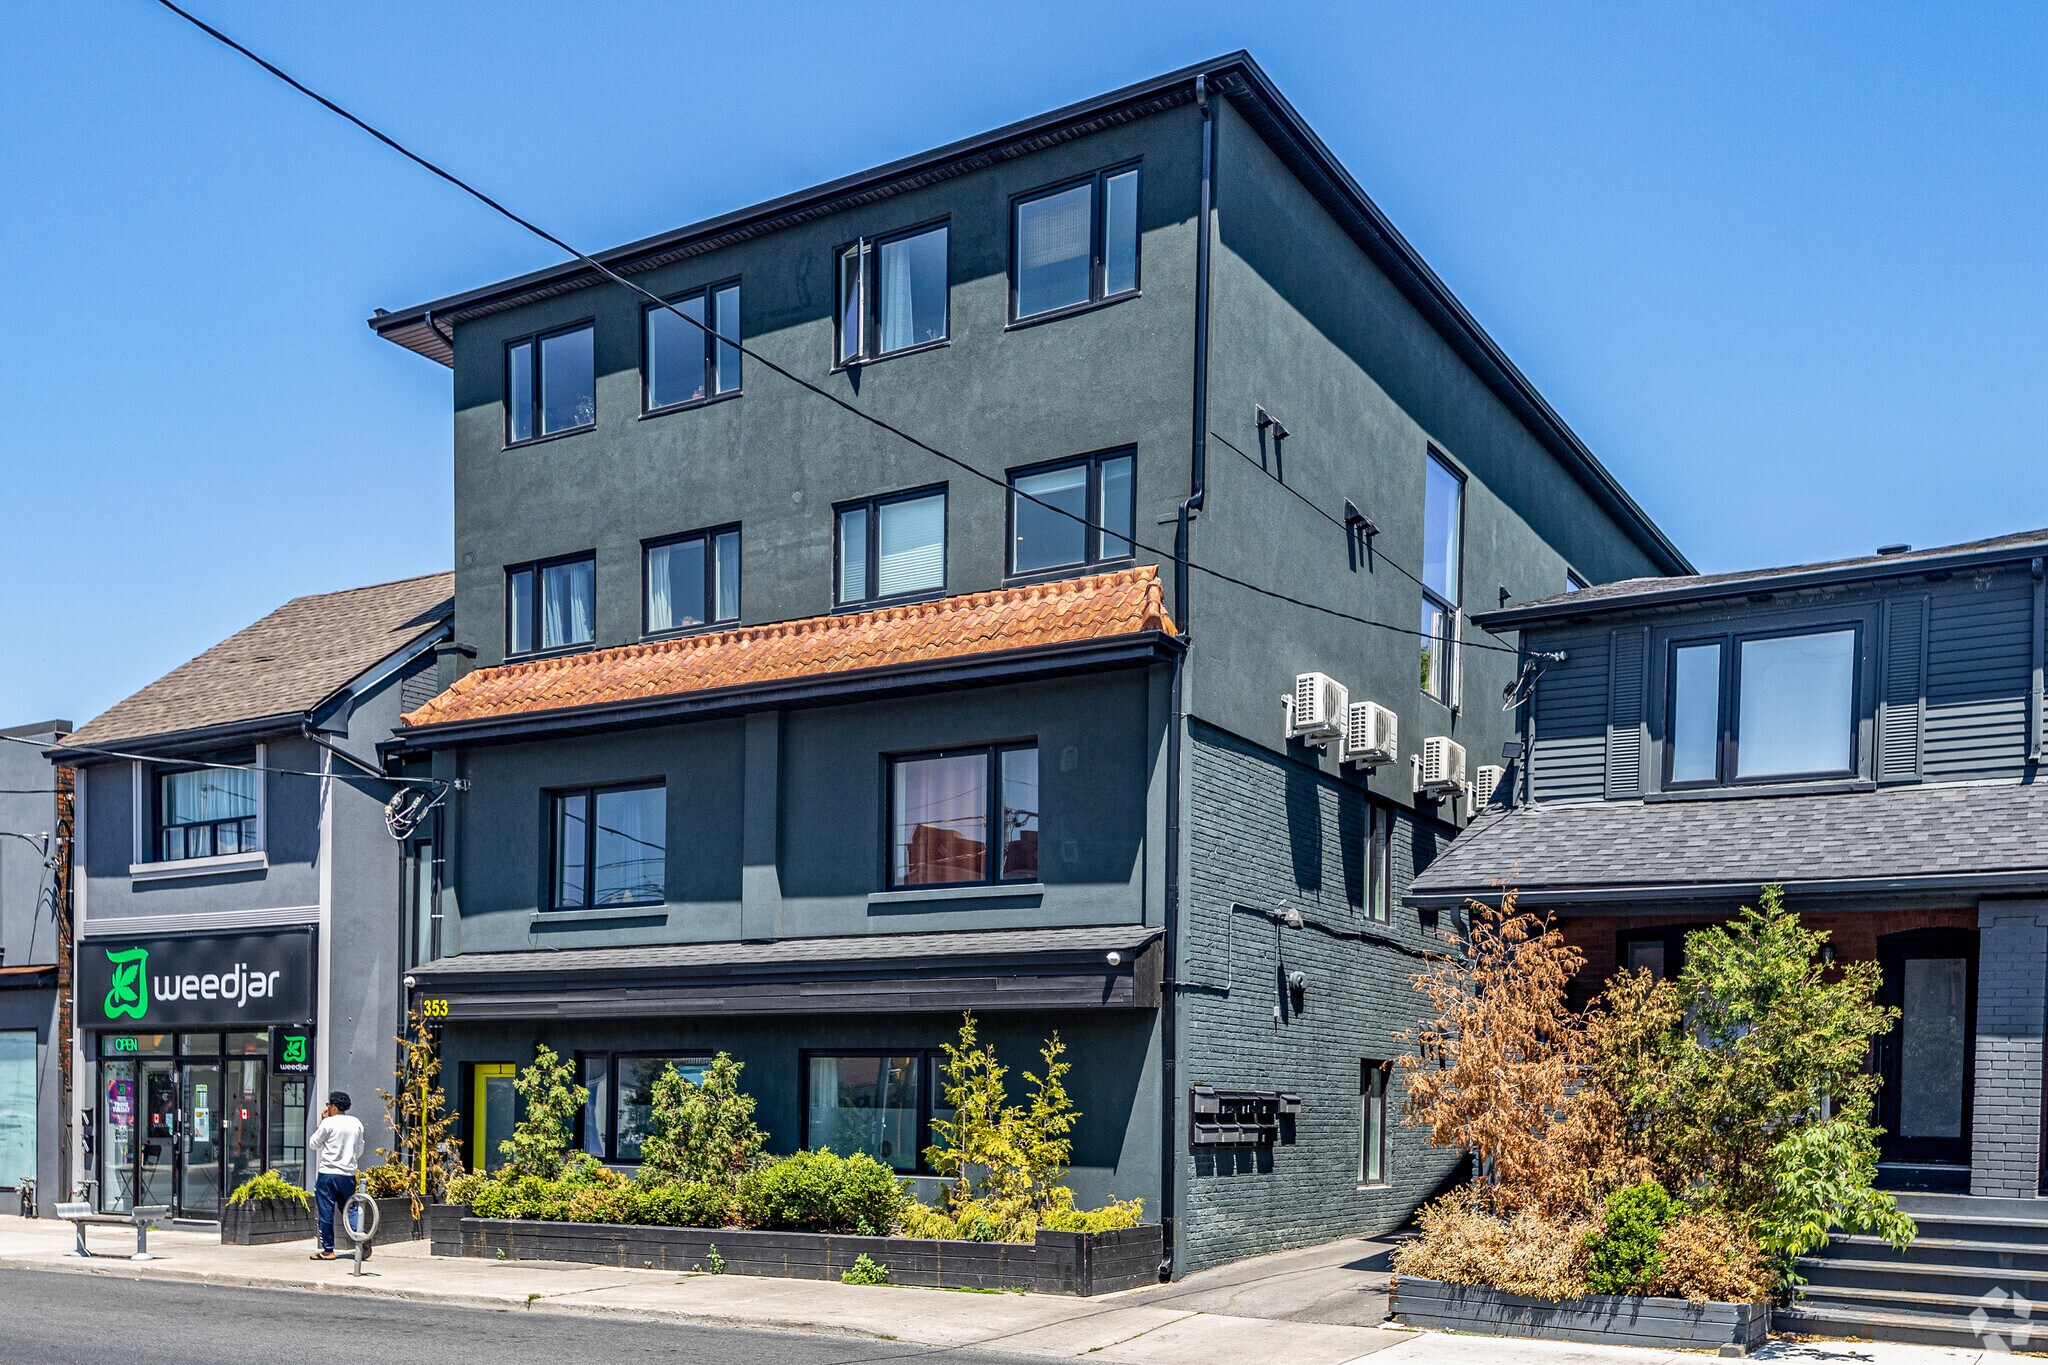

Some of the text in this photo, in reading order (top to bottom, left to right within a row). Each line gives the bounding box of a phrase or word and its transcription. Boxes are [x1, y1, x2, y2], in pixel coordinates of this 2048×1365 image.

[154, 963, 280, 1008] weedjar
[424, 999, 449, 1017] 353
[115, 1038, 138, 1051] OPEN
[280, 1063, 310, 1072] weedjar
